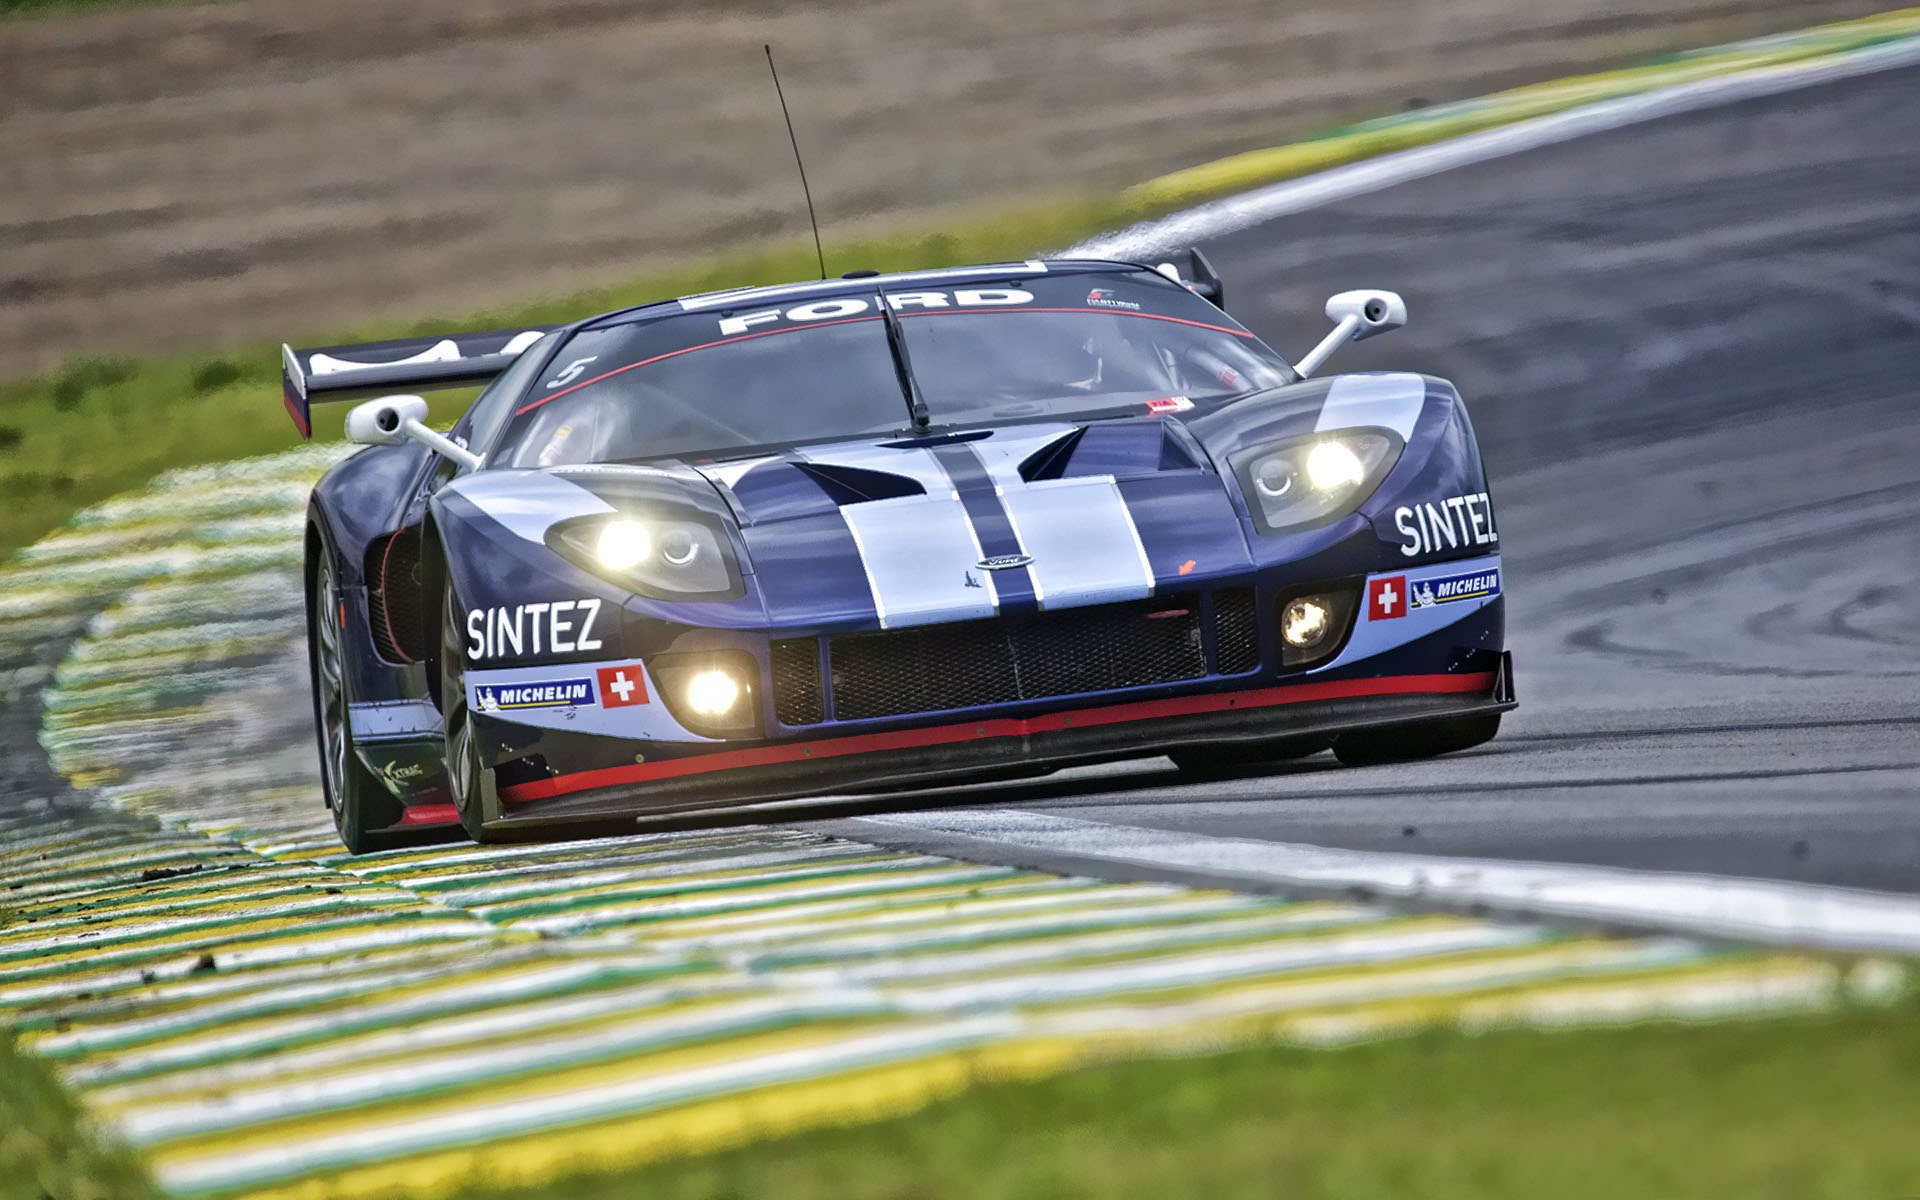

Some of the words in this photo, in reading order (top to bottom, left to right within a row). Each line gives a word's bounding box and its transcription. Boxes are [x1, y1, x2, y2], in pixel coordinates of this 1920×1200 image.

[718, 289, 1034, 336] FORD
[546, 356, 598, 388] 5
[1394, 492, 1498, 557] SINTEZ
[1437, 574, 1497, 598] MICHELIN
[467, 598, 602, 660] SINTEZ
[500, 684, 587, 705] MICHELIN
